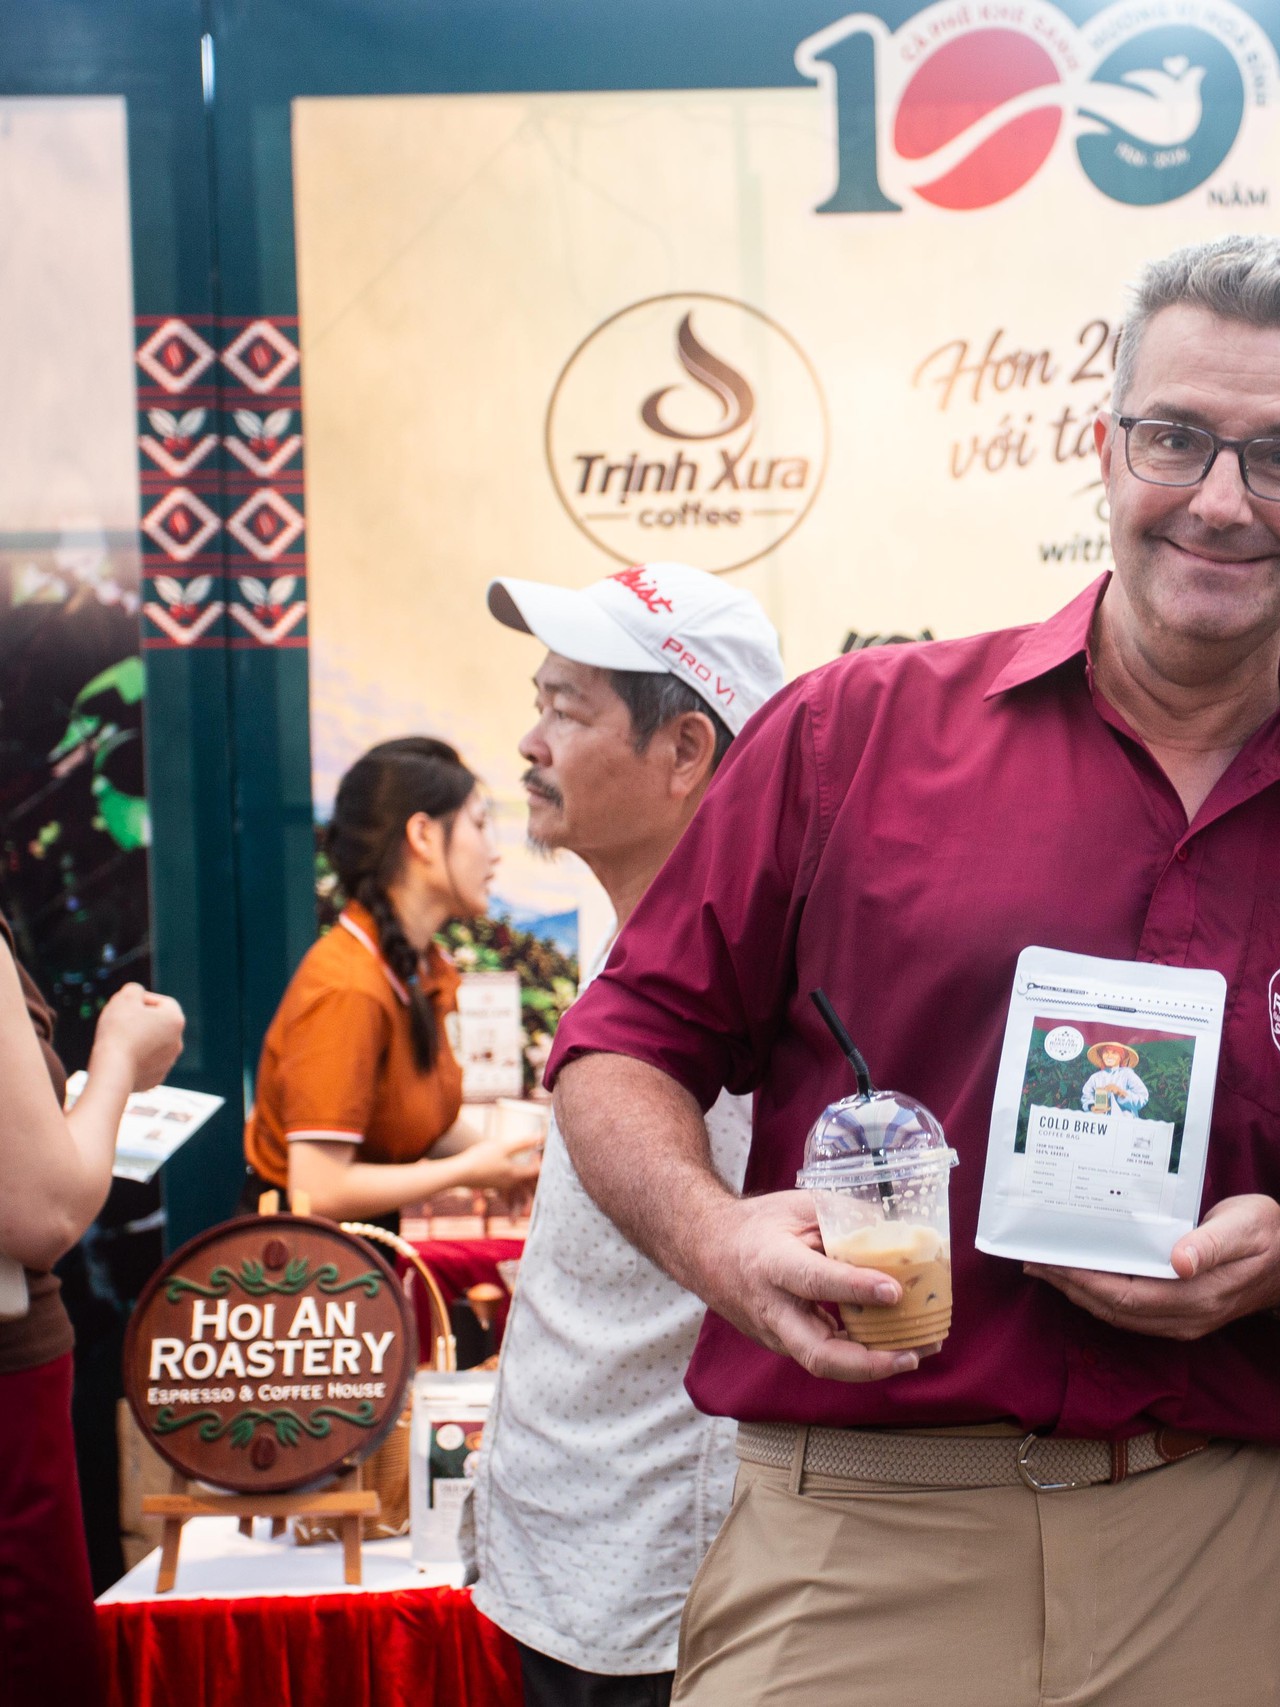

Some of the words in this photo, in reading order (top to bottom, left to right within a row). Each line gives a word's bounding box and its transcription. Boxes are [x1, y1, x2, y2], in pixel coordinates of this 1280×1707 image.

[912, 328, 1054, 411] Hơn
[950, 413, 1035, 479] với
[576, 450, 698, 504] Trịnh
[710, 449, 810, 491] Xưa
[638, 501, 742, 527] coffee
[1038, 533, 1113, 562] with
[661, 636, 712, 682] PRO
[1038, 1130, 1064, 1140] COFFEE
[1066, 1133, 1080, 1141] BAG
[1039, 1115, 1069, 1131] COLD
[1073, 1120, 1108, 1136] BREW
[191, 1298, 275, 1341] HOI
[288, 1296, 357, 1339] AN
[148, 1330, 395, 1381] ROASTERY
[147, 1386, 235, 1406] ESPRESSO
[238, 1385, 254, 1402] &
[257, 1384, 323, 1401] COFFEE
[327, 1382, 387, 1400] HOUSE
